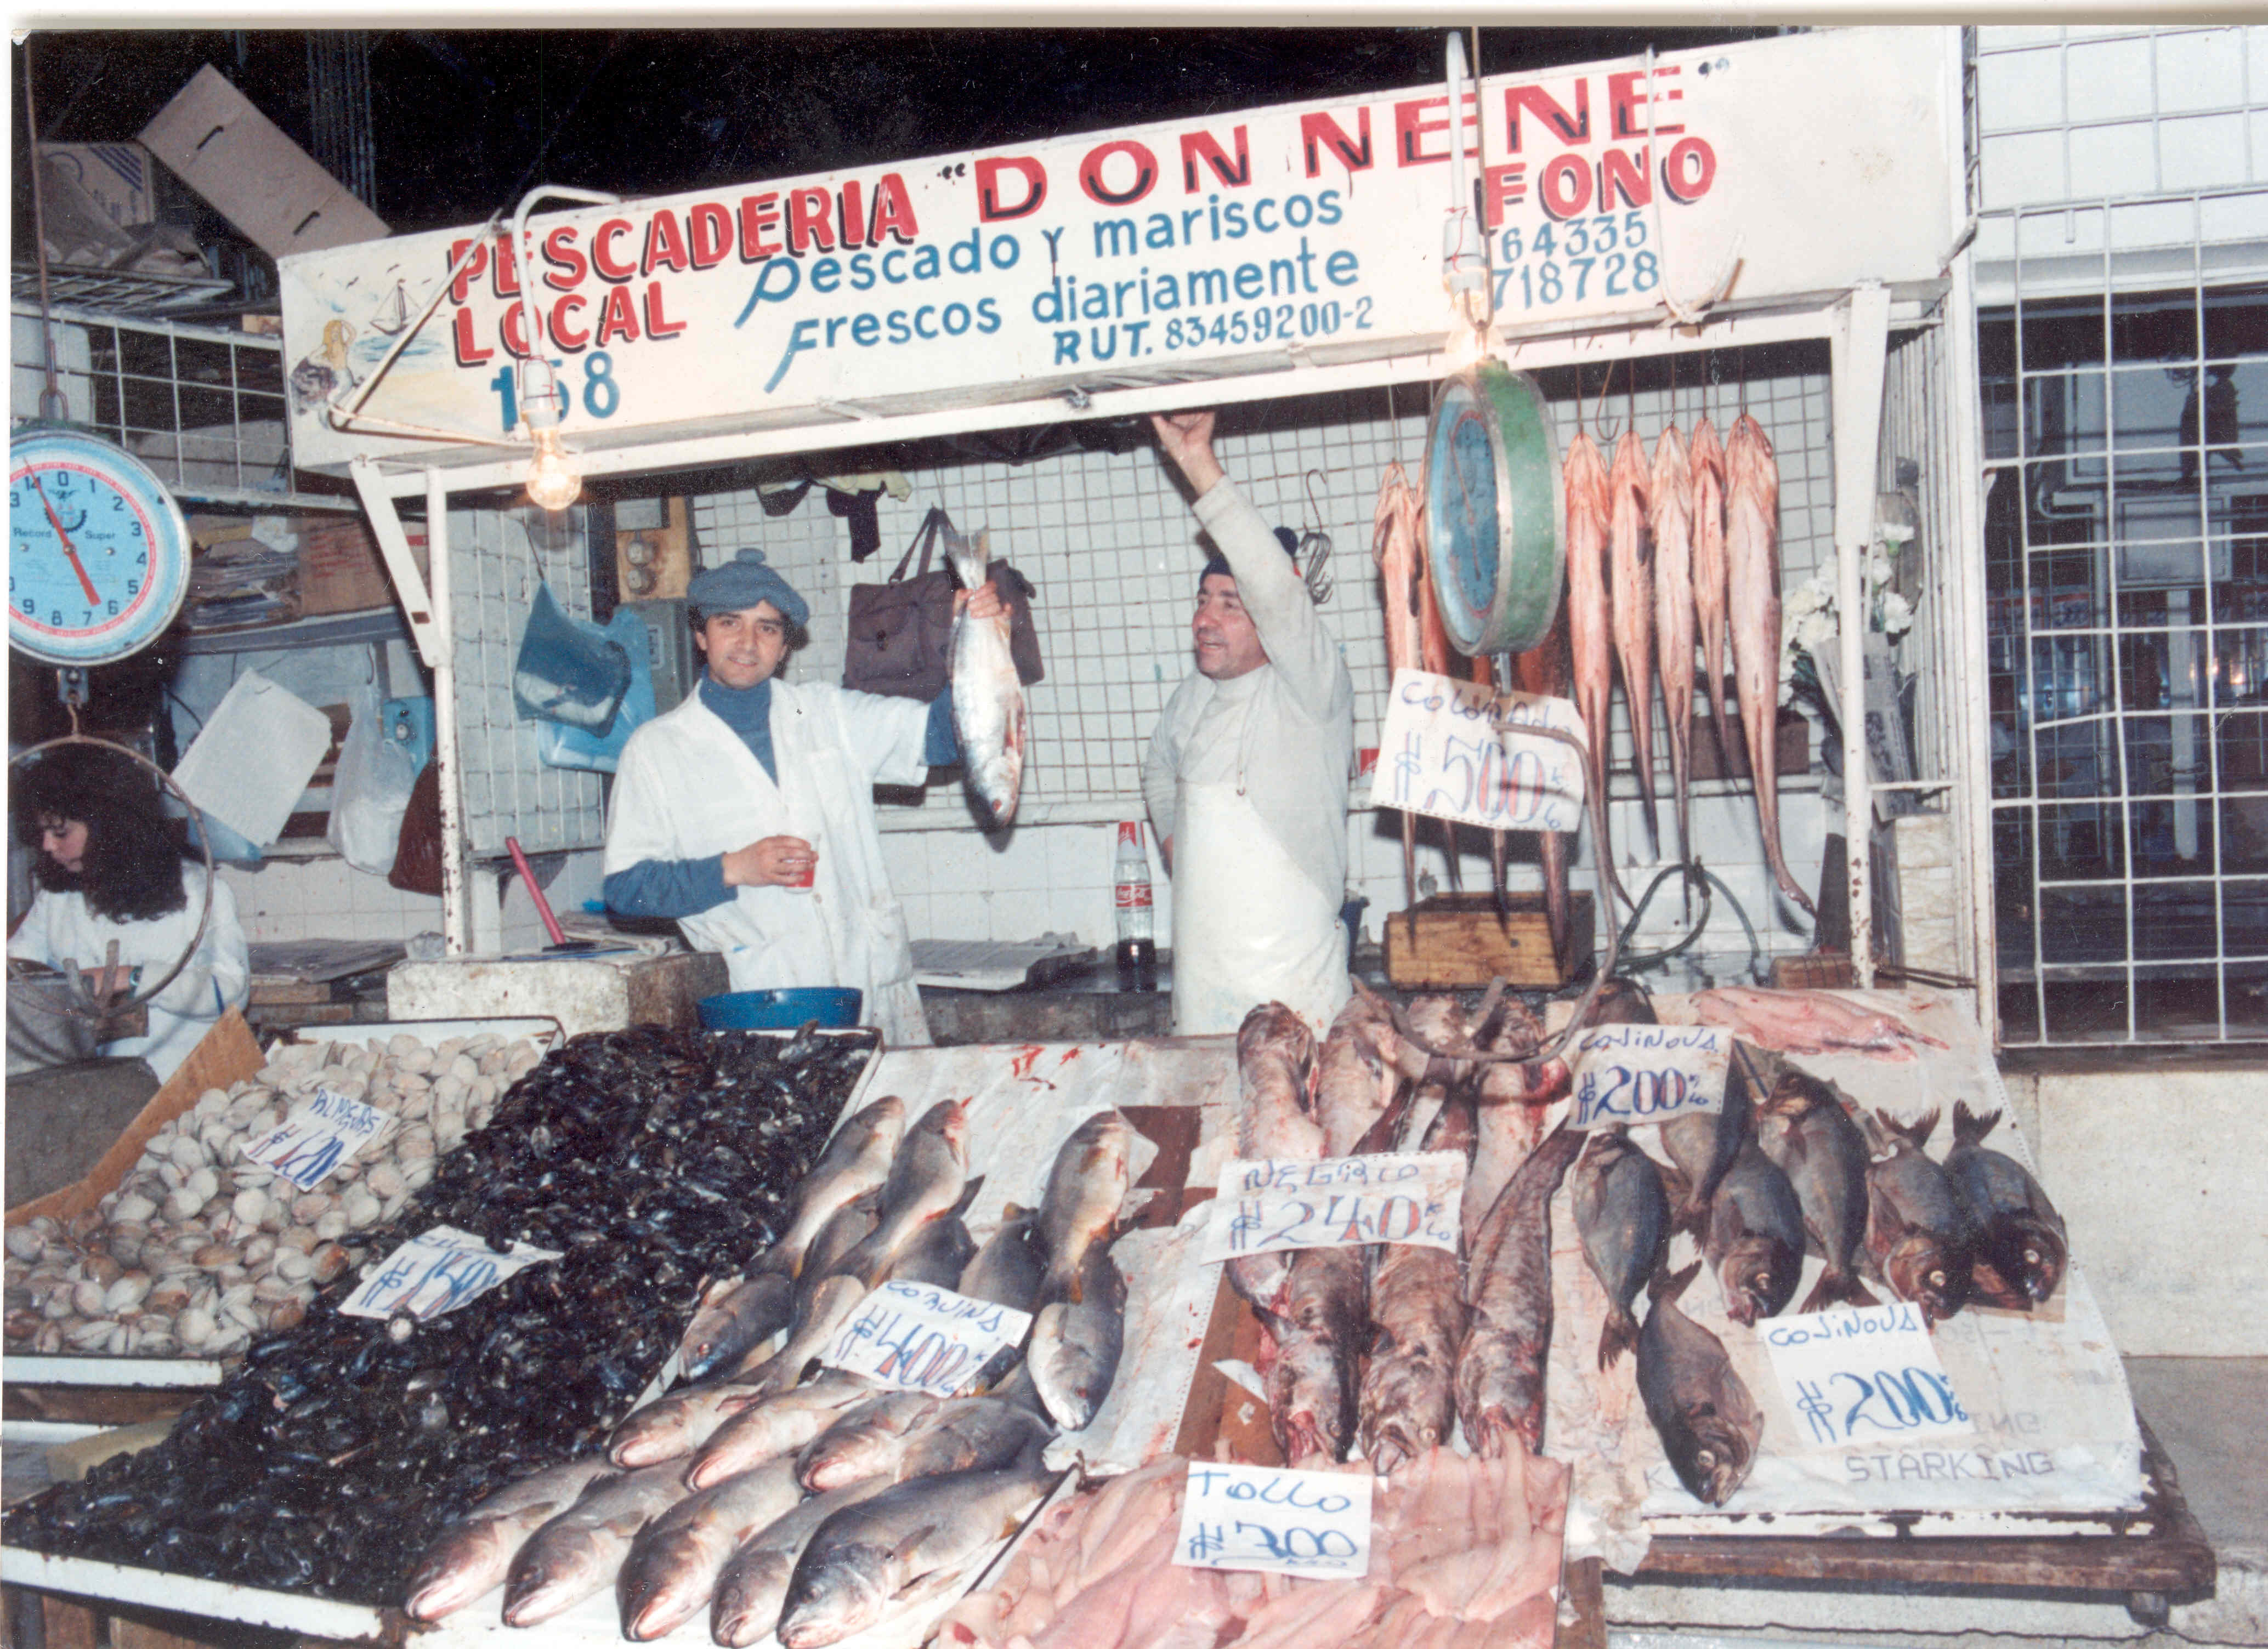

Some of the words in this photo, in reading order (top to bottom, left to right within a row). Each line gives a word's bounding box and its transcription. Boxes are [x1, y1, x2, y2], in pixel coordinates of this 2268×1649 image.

[1474, 137, 1717, 236] FONO
[445, 172, 919, 305] PESCADERIA
[1501, 211, 1647, 264] 64335
[734, 227, 1020, 329] Pescado
[1093, 189, 1343, 258] mariscos
[1492, 250, 1659, 311] 718728
[453, 281, 687, 366] LOCAL
[764, 297, 1002, 394] Frescos
[1031, 236, 1359, 323] diariamente
[1165, 296, 1374, 352] 83459200-2
[58, 470, 69, 487] 0
[112, 496, 124, 511] 2
[13, 527, 52, 538] Record
[85, 530, 116, 541] Super
[131, 521, 141, 537] 3
[136, 551, 146, 566] 4
[128, 579, 139, 595] 5
[22, 599, 35, 615] 9
[82, 611, 92, 626] 7
[1845, 1451, 2055, 1481] STARKING
